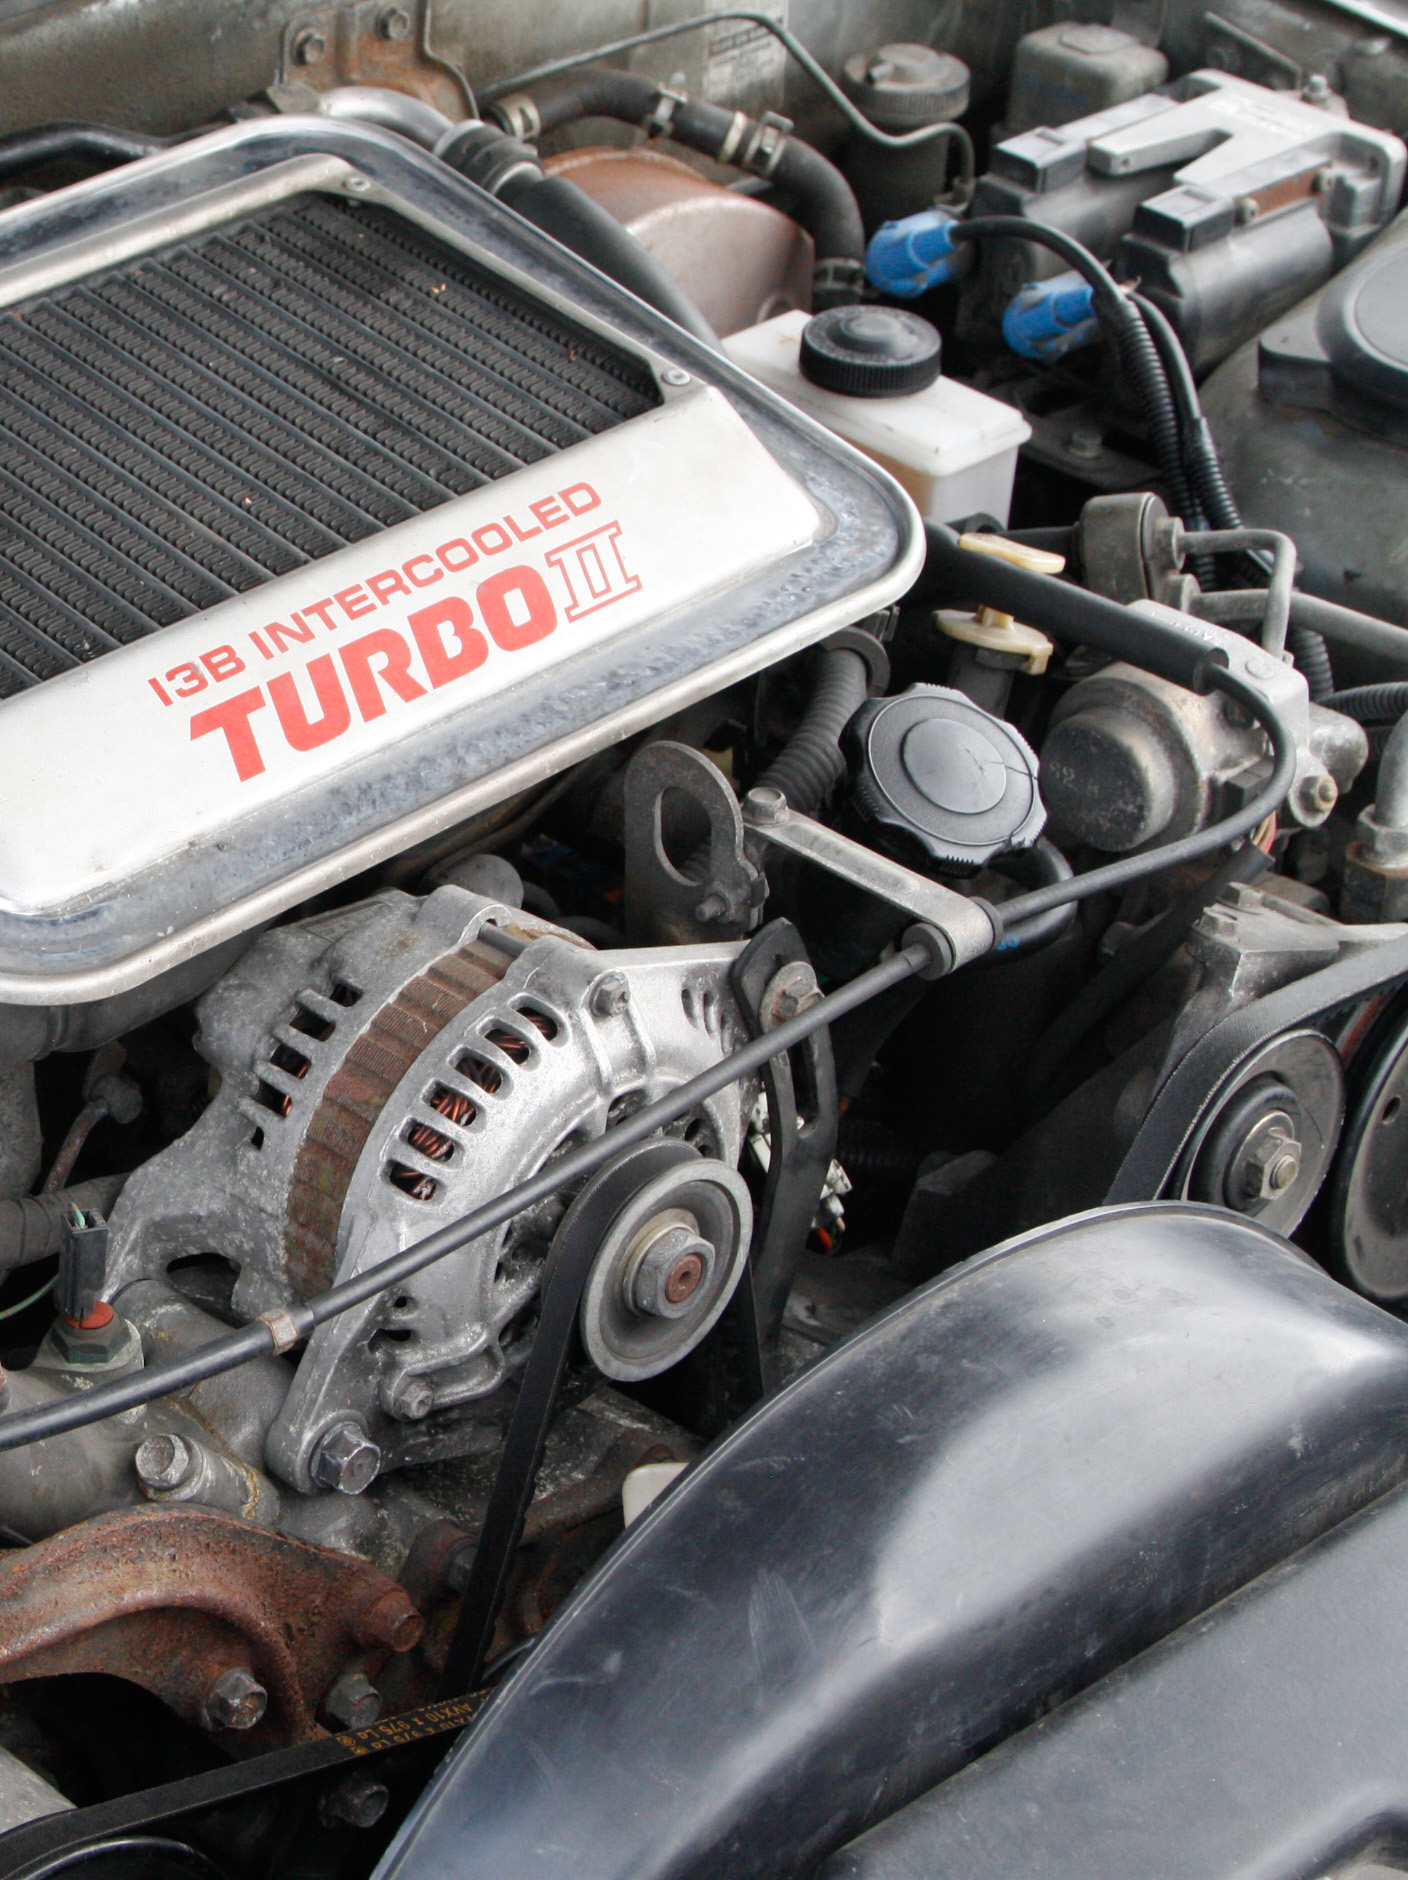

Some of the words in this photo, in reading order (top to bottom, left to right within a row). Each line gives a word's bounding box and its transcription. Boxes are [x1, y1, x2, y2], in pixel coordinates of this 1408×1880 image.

[249, 482, 602, 660] INTERCOOLED
[190, 564, 558, 782] TURBO
[545, 520, 643, 623] II
[380, 1720, 410, 1735] 975
[426, 1703, 473, 1722] AVX10
